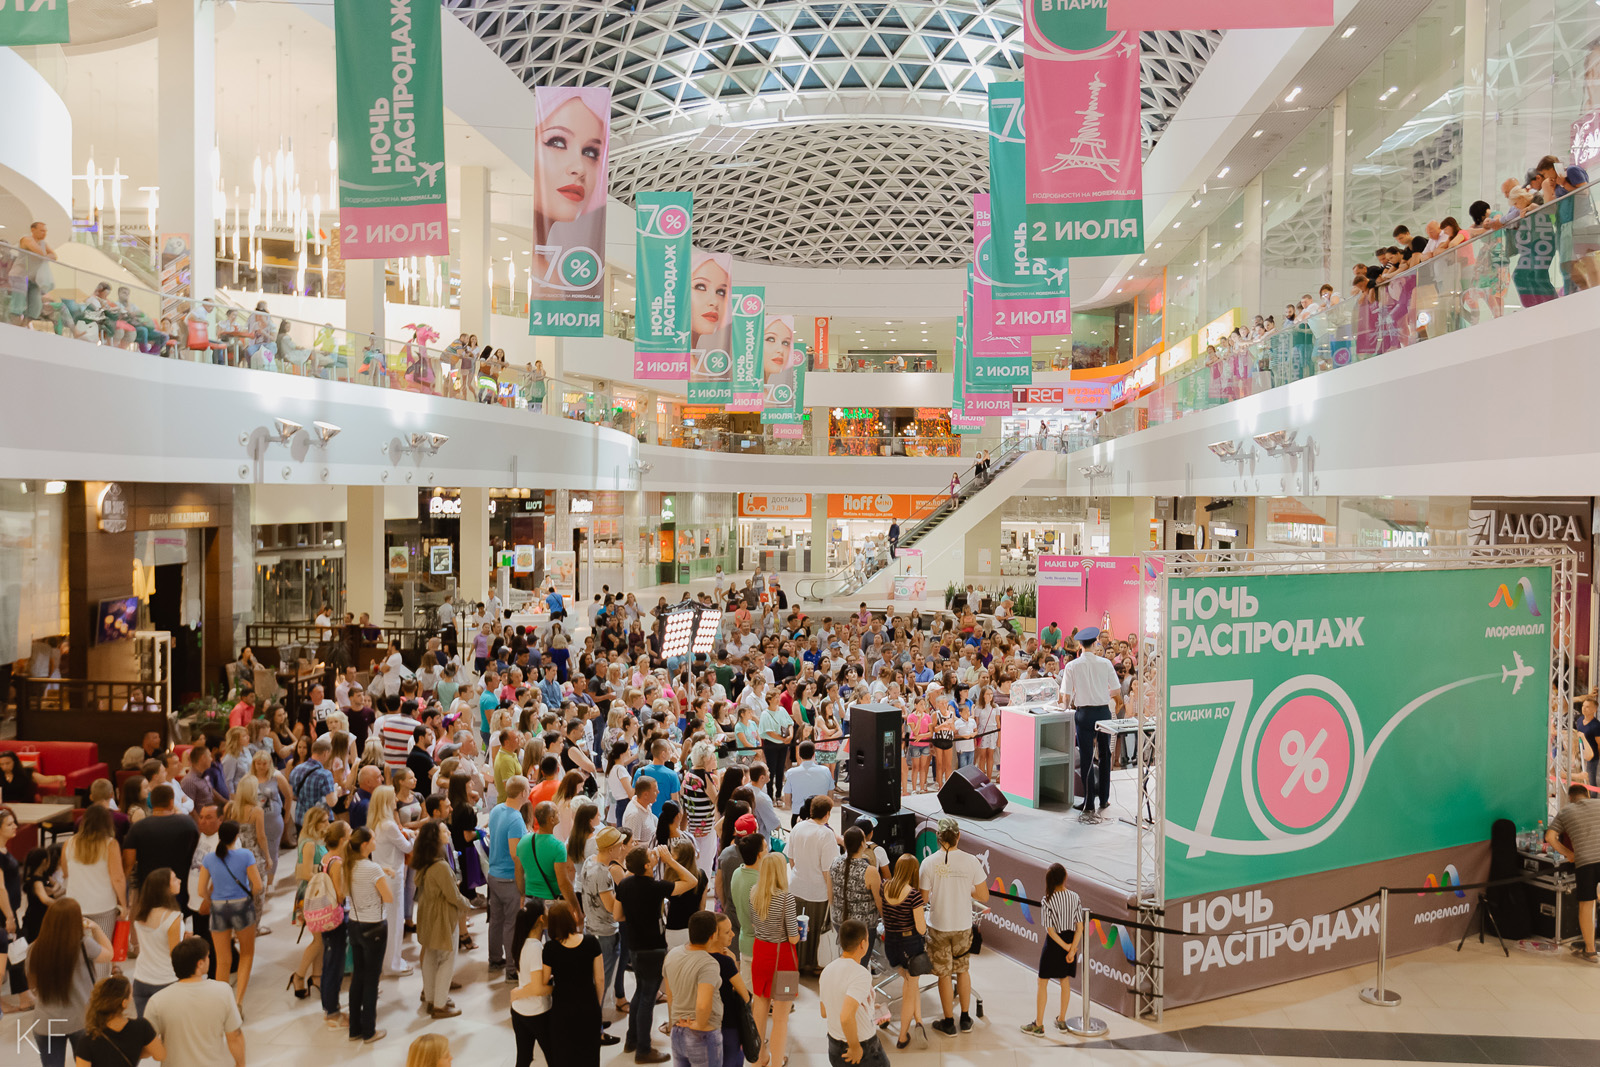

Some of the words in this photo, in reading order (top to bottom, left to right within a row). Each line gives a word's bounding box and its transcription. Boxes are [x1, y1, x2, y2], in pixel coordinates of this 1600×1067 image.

[1057, 0, 1108, 11] ПАРИ
[390, 0, 416, 173] РАСПРОДАЖ
[369, 97, 392, 174] НОЧЬ
[1092, 189, 1136, 197] MOREMALL.RU
[344, 224, 358, 244] 2
[366, 221, 442, 244] ИЮЛЯ
[1032, 221, 1047, 241] 2
[1055, 218, 1138, 240] ИЮЛЯ
[664, 244, 677, 336] РАСПРОДАЖ
[533, 311, 543, 326] 2
[547, 312, 600, 327] ИЮЛЯ
[651, 296, 663, 336] НОЧЬ
[995, 311, 1006, 325] 2
[1011, 309, 1066, 325] ИЮЛЯ
[745, 320, 754, 382] РАСПРОДАЖ
[635, 360, 644, 372] 2
[647, 361, 688, 372] ИЮЛЯ
[737, 354, 745, 382] НОЧЬ
[975, 366, 983, 377] 2
[987, 365, 1029, 377] ИЮЛЯ
[689, 389, 696, 398] 2
[698, 388, 732, 398] ИЮЛЯ
[1067, 387, 1110, 396] МУЗЫКА
[734, 398, 762, 406] ИЮЛЯ
[967, 400, 974, 409] 2
[976, 400, 1010, 409] ИЮЛЯ
[1074, 396, 1102, 404] СОФТ
[771, 496, 804, 504] ДОСТАВКА
[843, 494, 873, 511] Hoff
[1499, 512, 1581, 544] АДОРА
[1044, 560, 1067, 568] MAKE
[1068, 560, 1080, 568] UP
[1096, 561, 1116, 569] FREE
[1171, 586, 1259, 621] НОЧЬ
[1171, 616, 1365, 659] РАСПРОДАЖ
[1169, 707, 1212, 722] СКИДКИ
[1214, 706, 1230, 720] ДО
[1183, 889, 1274, 937] НОЧЬ
[1183, 903, 1380, 976] РАСПРОДАЖ
